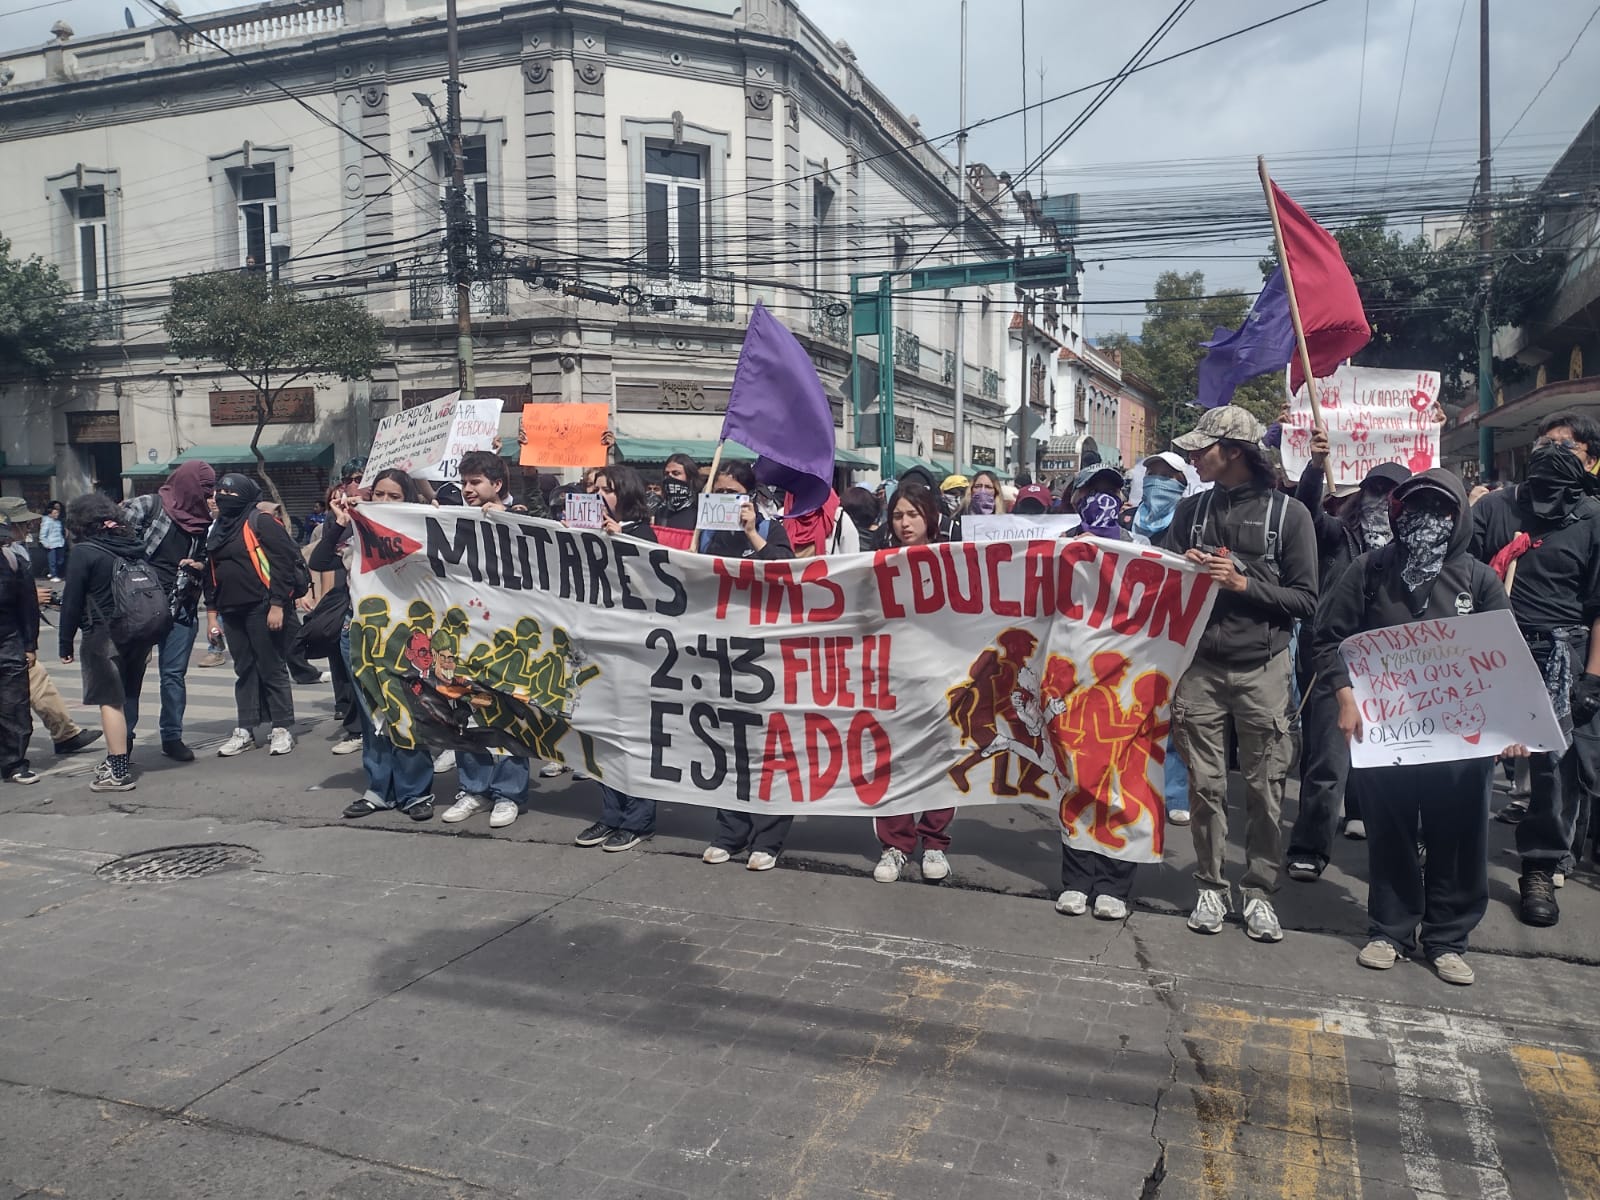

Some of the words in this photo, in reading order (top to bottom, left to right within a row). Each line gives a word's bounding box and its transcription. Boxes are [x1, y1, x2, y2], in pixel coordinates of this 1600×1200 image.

[657, 391, 705, 411] ABC
[380, 419, 392, 431] NI
[395, 403, 432, 426] PERDON
[407, 418, 418, 429] NI
[422, 404, 455, 424] OLVIDO
[438, 459, 458, 478] 43
[1041, 460, 1074, 470] HOTEL
[425, 516, 688, 617] MILITARES
[1369, 668, 1418, 695] PARA
[1424, 662, 1466, 681] QUE
[1469, 650, 1507, 674] NO
[650, 700, 892, 807] ESTADO
